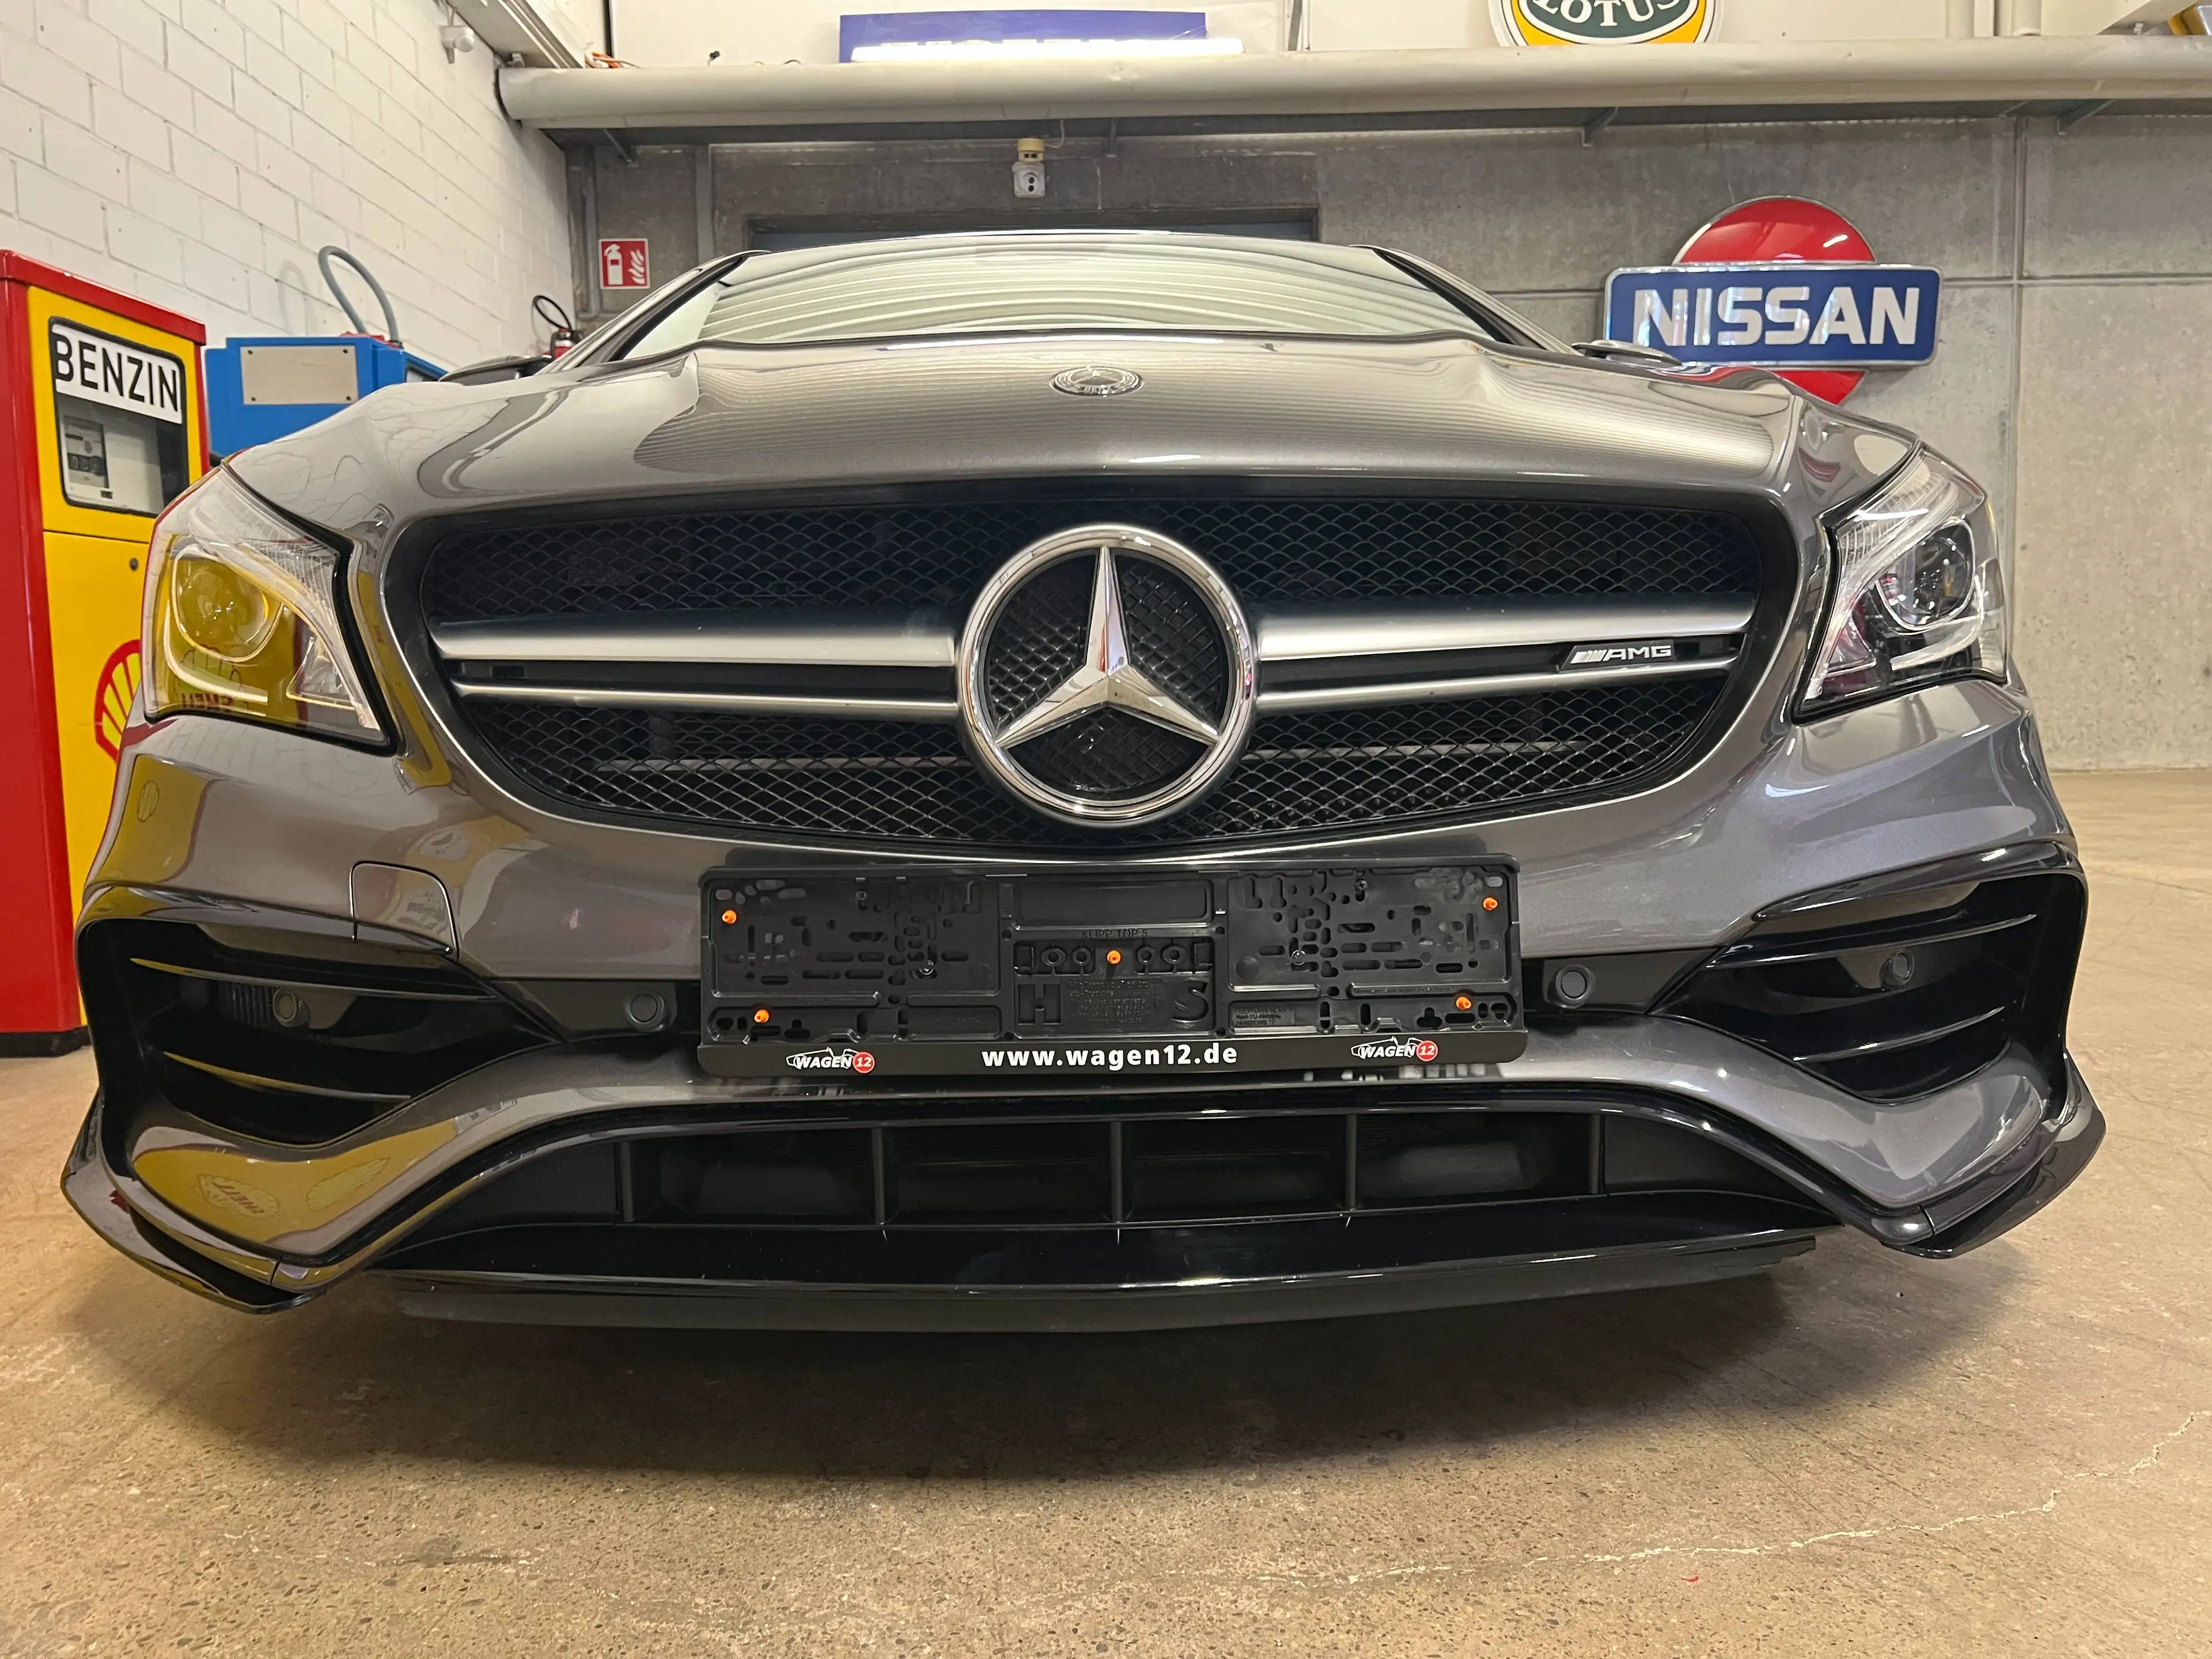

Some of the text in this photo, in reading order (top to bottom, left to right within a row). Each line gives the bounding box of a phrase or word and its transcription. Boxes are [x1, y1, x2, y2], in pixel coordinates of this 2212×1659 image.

[1634, 286, 1920, 347] NISSAN
[54, 333, 178, 412] BENZIN
[1603, 645, 1672, 661] AMG
[1117, 927, 1138, 938] TOP
[1142, 928, 1148, 938] 5
[982, 1043, 1237, 1071] www.wagen12.de
[1361, 1045, 1435, 1058] WAGEN 12
[797, 1056, 872, 1069] WAGEN 12
